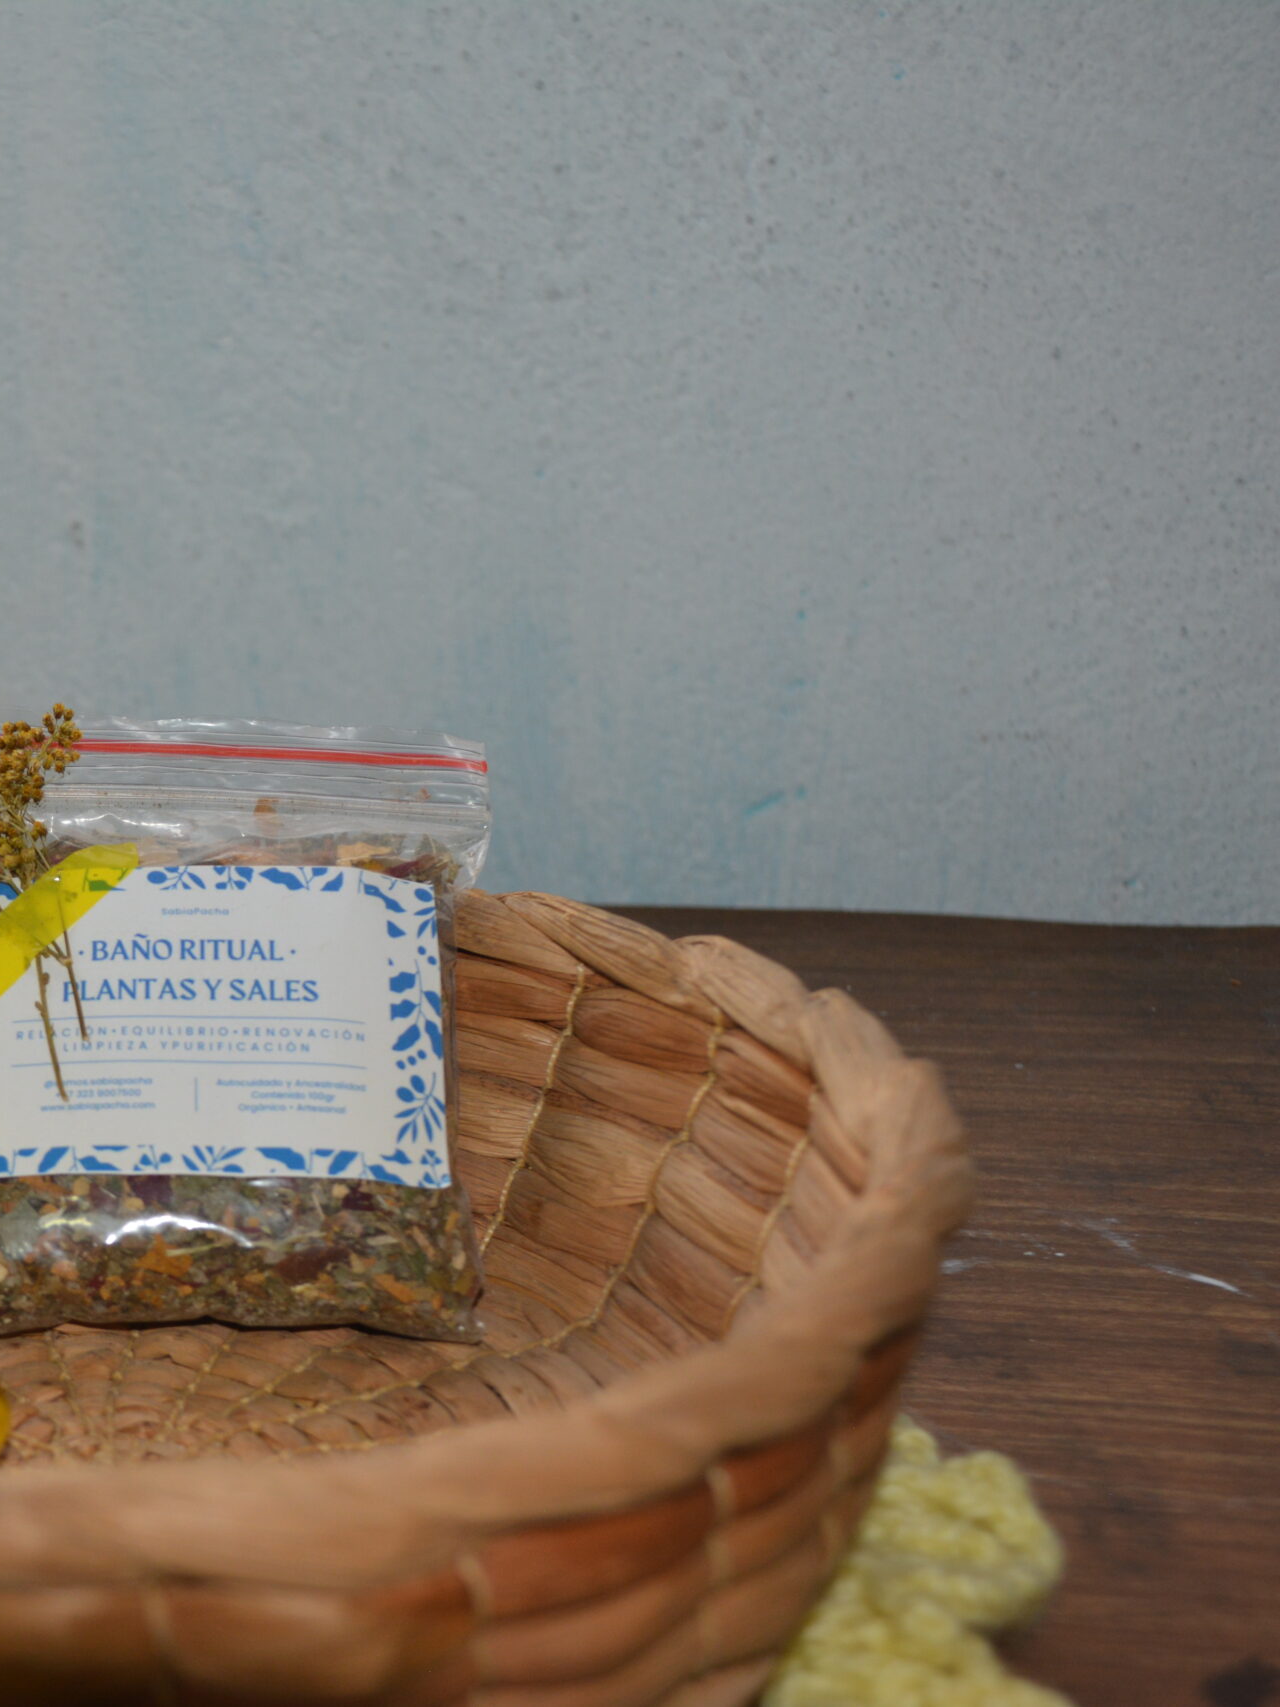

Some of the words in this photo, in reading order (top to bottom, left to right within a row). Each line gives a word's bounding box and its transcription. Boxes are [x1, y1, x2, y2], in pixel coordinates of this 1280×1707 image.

[91, 934, 171, 961] BAÑO
[180, 939, 284, 961] RITUAL
[62, 979, 197, 1002] PLANTAS
[199, 978, 223, 1000] Y
[229, 979, 319, 1002] SALES
[63, 1040, 148, 1052] LIMPIEZA
